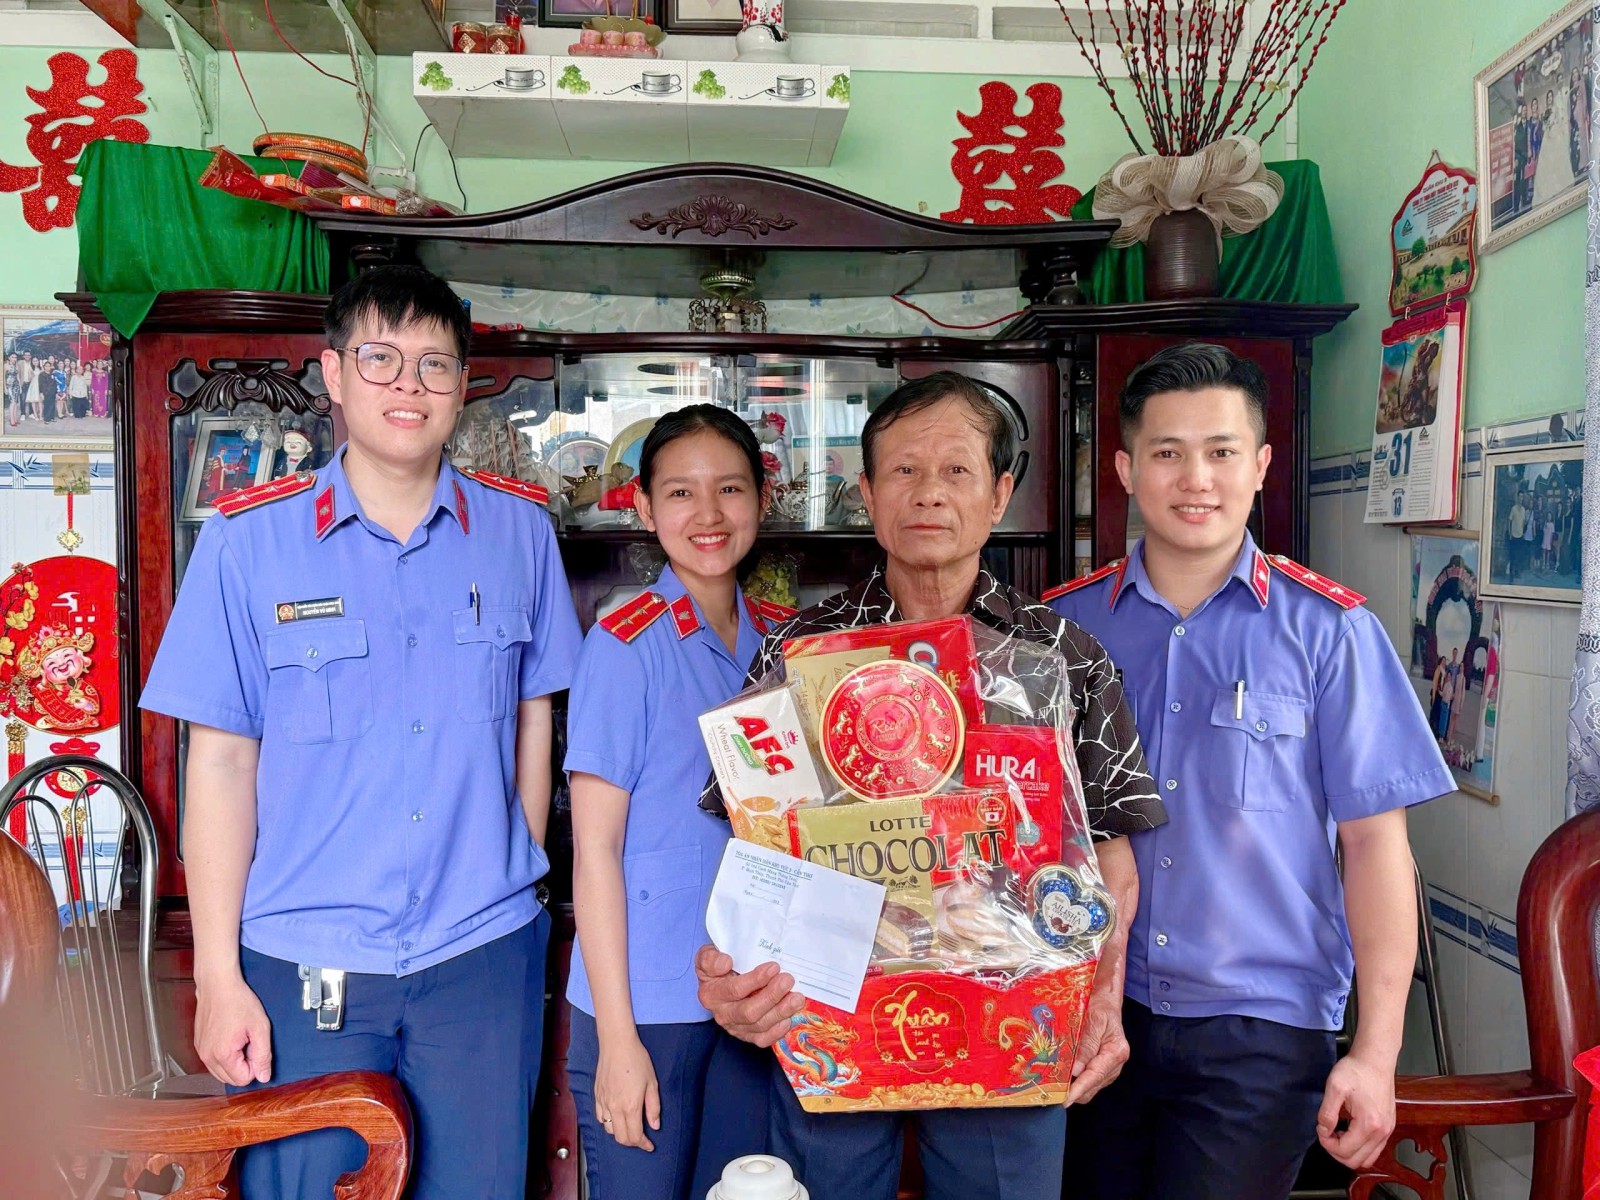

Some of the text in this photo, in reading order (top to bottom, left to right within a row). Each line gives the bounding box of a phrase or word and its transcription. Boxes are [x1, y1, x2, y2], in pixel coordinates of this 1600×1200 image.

[1390, 430, 1413, 476] 31
[1393, 496, 1402, 516] 13
[717, 723, 732, 753] Wheat
[733, 716, 795, 776] AFC
[976, 754, 1036, 779] HURA
[869, 815, 932, 832] LOTTE
[804, 829, 1007, 878] CHOCOLAT
